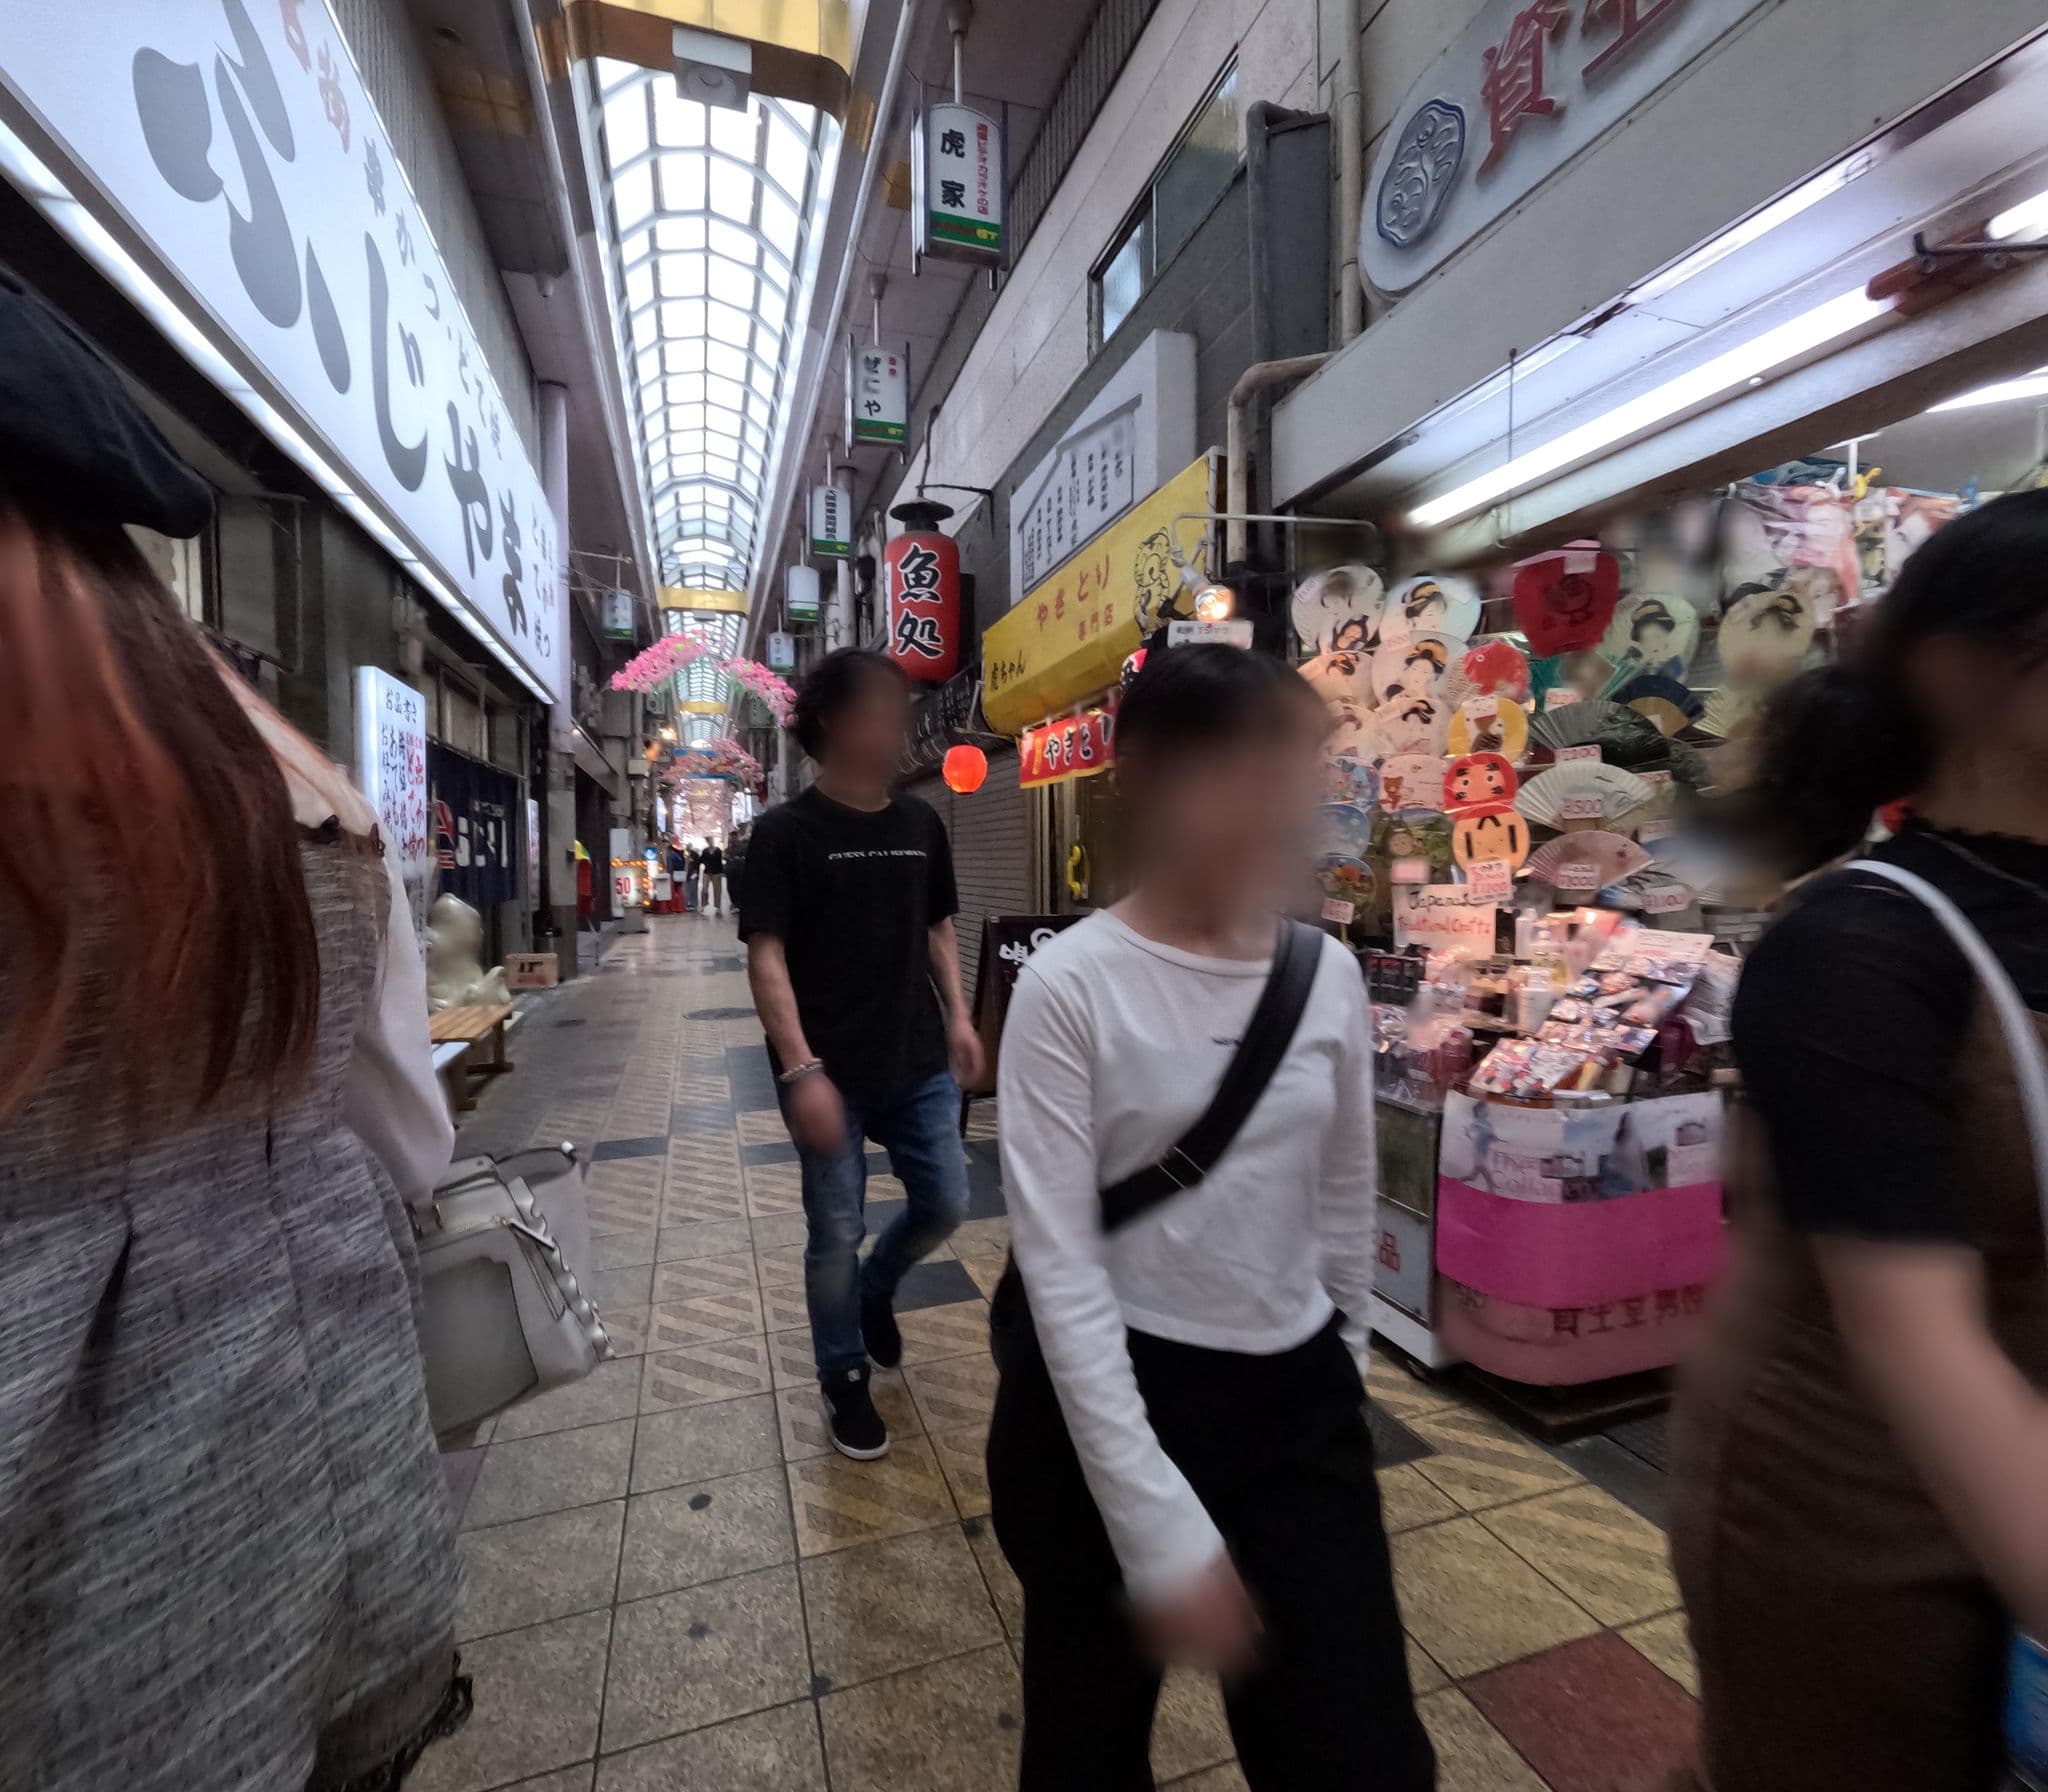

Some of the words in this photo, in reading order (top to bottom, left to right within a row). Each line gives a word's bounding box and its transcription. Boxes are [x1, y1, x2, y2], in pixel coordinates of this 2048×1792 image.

[940, 128, 965, 208] 虎家
[897, 542, 944, 658] 魚処
[1036, 554, 1110, 632] やきとり
